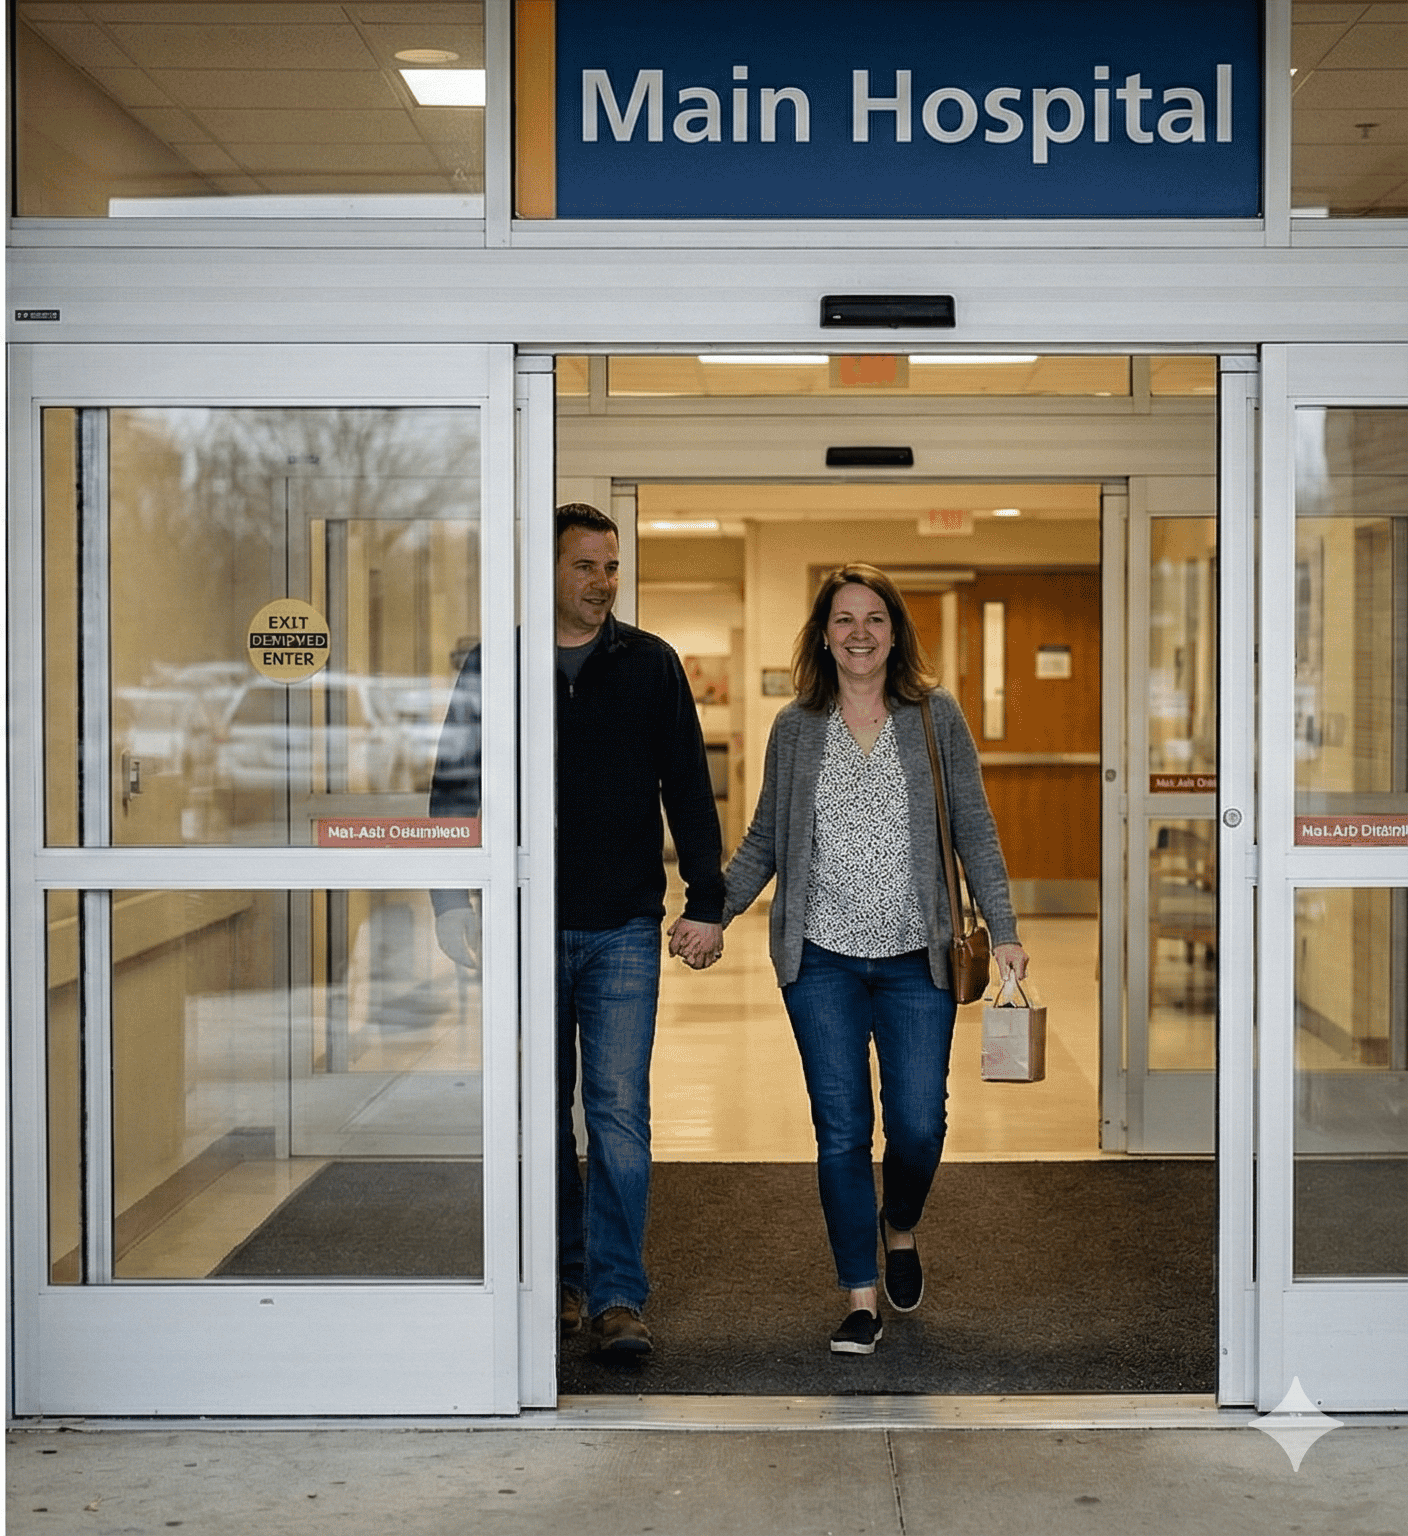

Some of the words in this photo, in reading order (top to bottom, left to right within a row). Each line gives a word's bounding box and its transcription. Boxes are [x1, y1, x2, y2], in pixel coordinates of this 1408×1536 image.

[581, 65, 811, 144] Main
[851, 64, 1233, 165] Hospital
[268, 615, 309, 630] EXIT
[263, 651, 315, 666] ENTER
